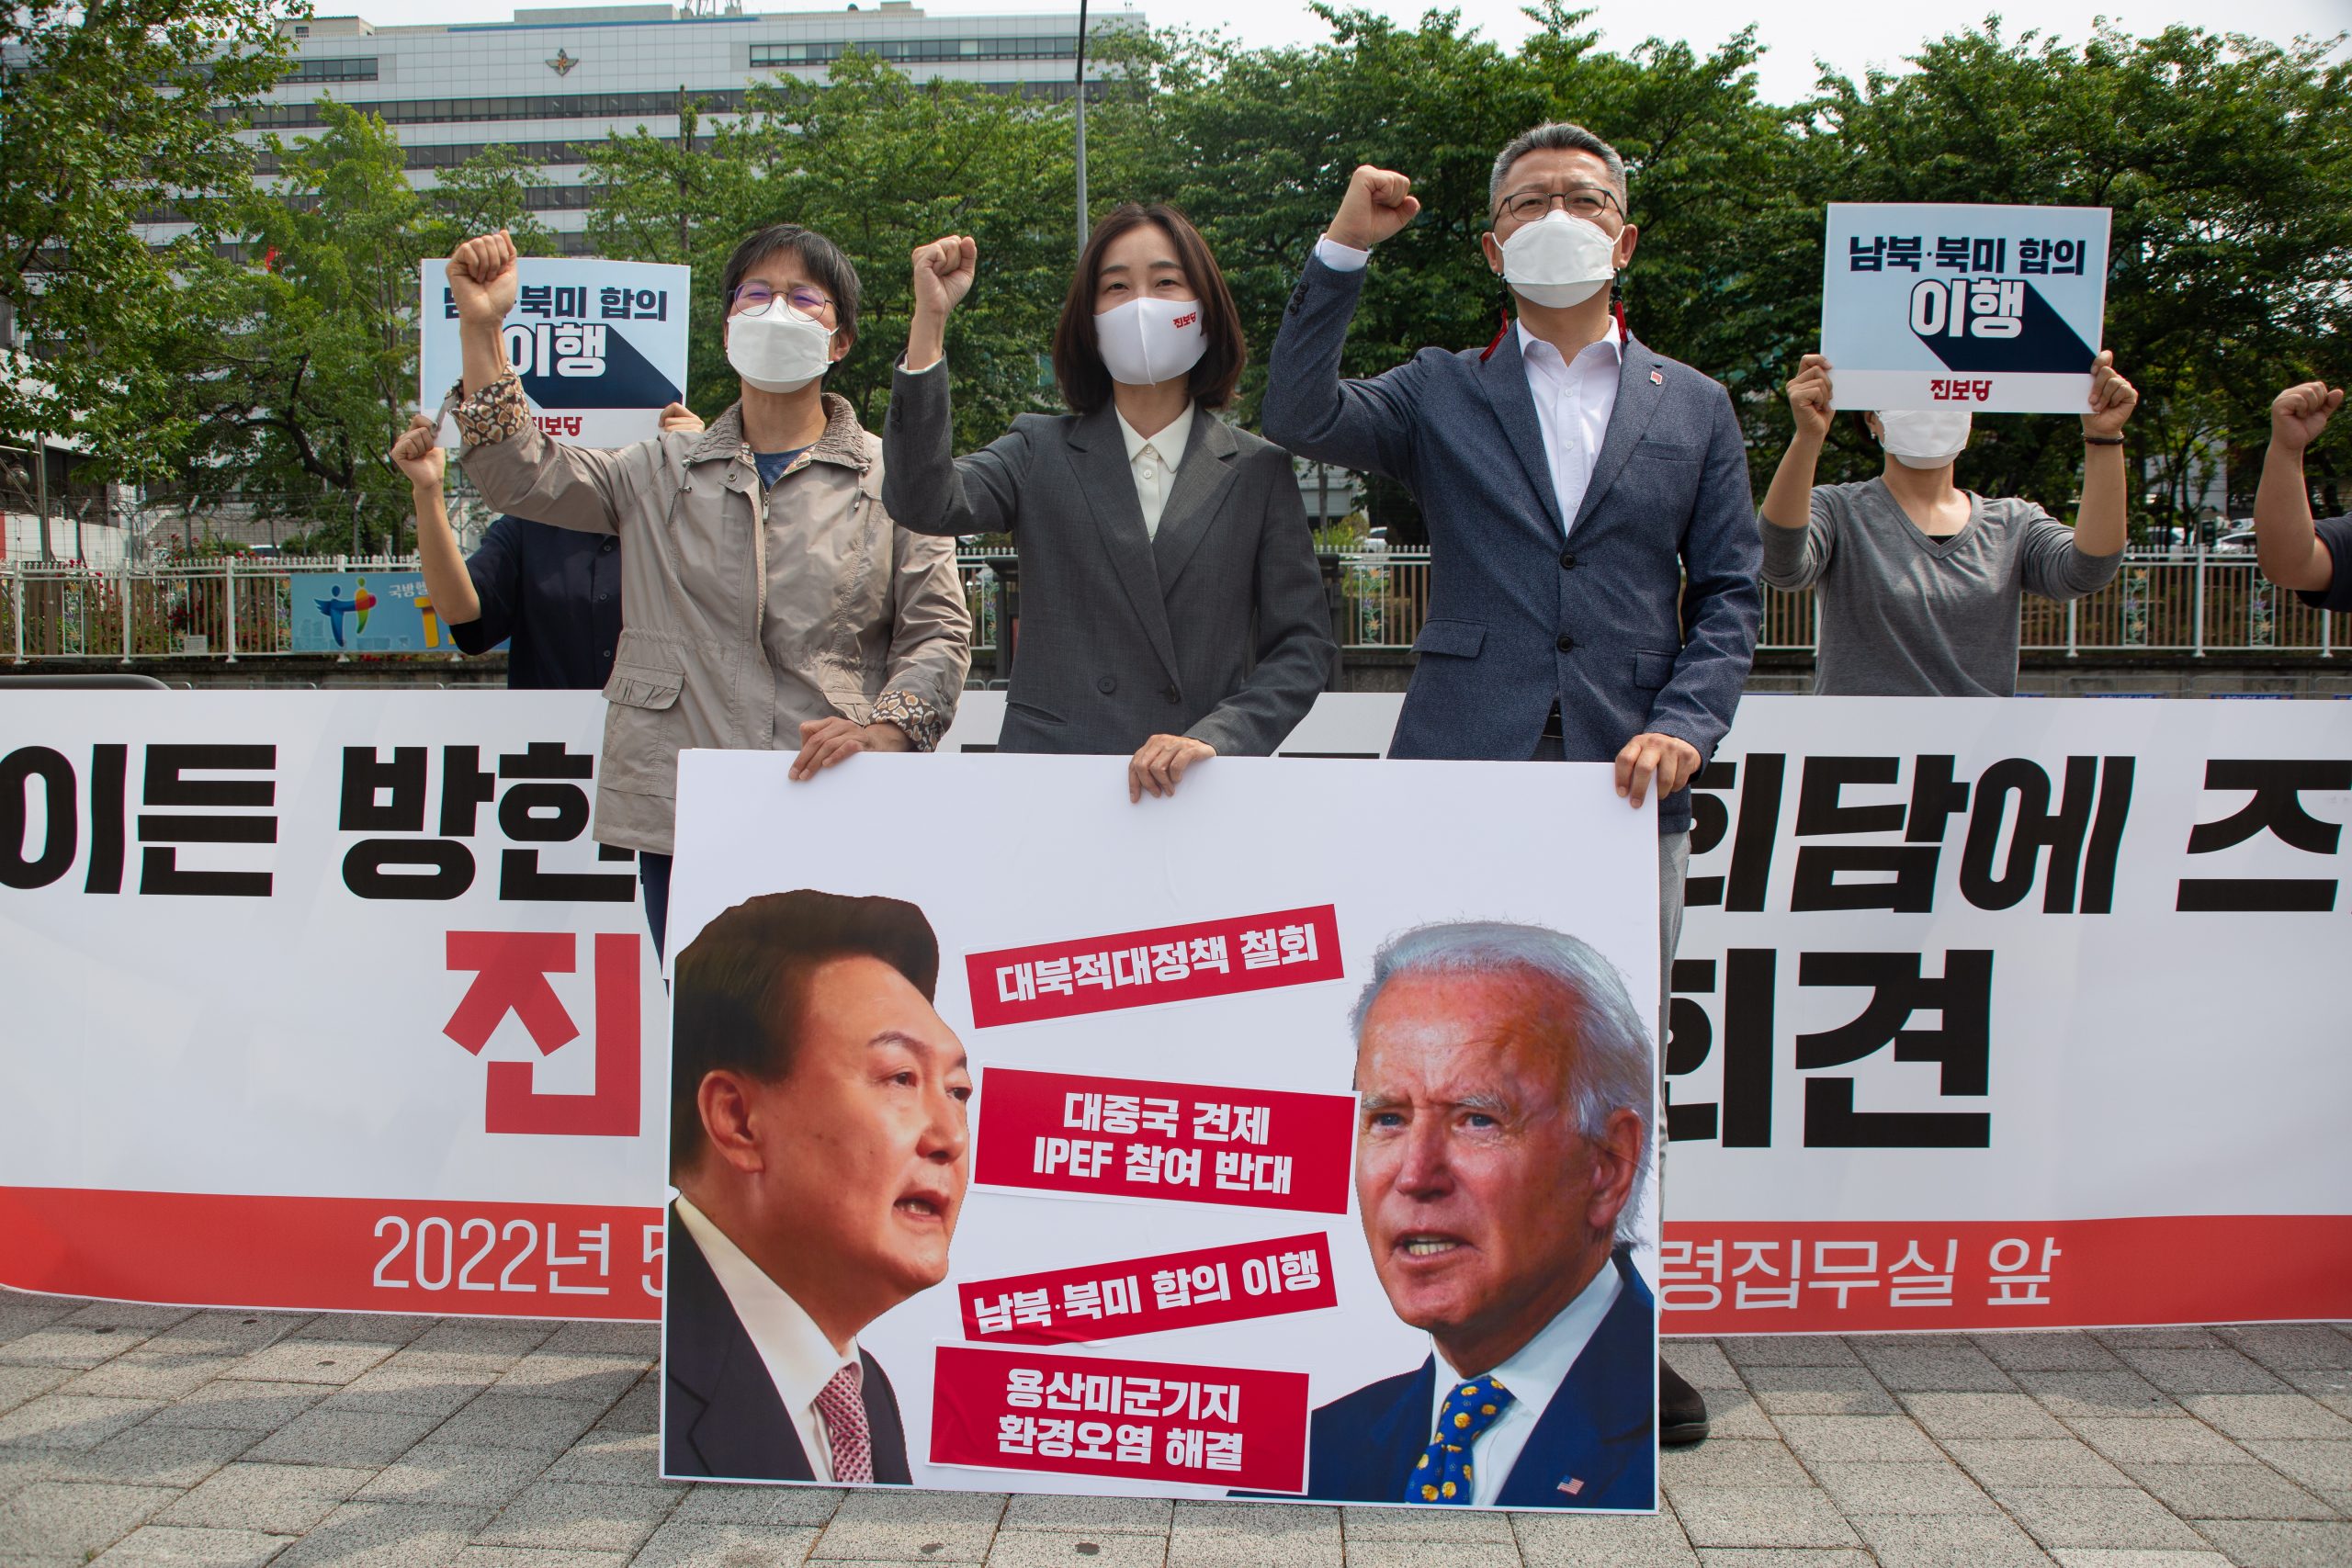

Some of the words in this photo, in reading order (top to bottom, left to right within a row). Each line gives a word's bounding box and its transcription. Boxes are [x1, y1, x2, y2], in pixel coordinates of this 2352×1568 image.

[1850, 236, 2006, 273] 남북·북미
[2019, 238, 2086, 275] 합의
[601, 288, 666, 321] 합의
[1911, 278, 2024, 338] 이행
[503, 322, 606, 378] 이행
[1931, 380, 1991, 401] 진보당
[0, 744, 277, 897] 이든
[339, 742, 637, 902] 방한
[996, 936, 1229, 1002] 대북적대정책
[1240, 923, 1318, 969] 철회
[444, 931, 640, 1136] 진
[1064, 1093, 1179, 1137] 대중국
[1193, 1102, 1270, 1145] 견제
[1034, 1137, 1114, 1178] IPEF
[1125, 1144, 1202, 1186] 참여
[1216, 1152, 1292, 1194] 반대
[373, 1215, 610, 1295] 2022년
[1659, 1238, 1958, 1311] 령집무실
[1988, 1237, 2062, 1305] 앞
[975, 1276, 1141, 1334] 남북·북미
[1152, 1263, 1230, 1309] 합의
[1242, 1250, 1320, 1295] 이행
[1007, 1369, 1239, 1423] 용산미군기지
[998, 1415, 1152, 1463] 환경오염
[1166, 1428, 1242, 1471] 해결
